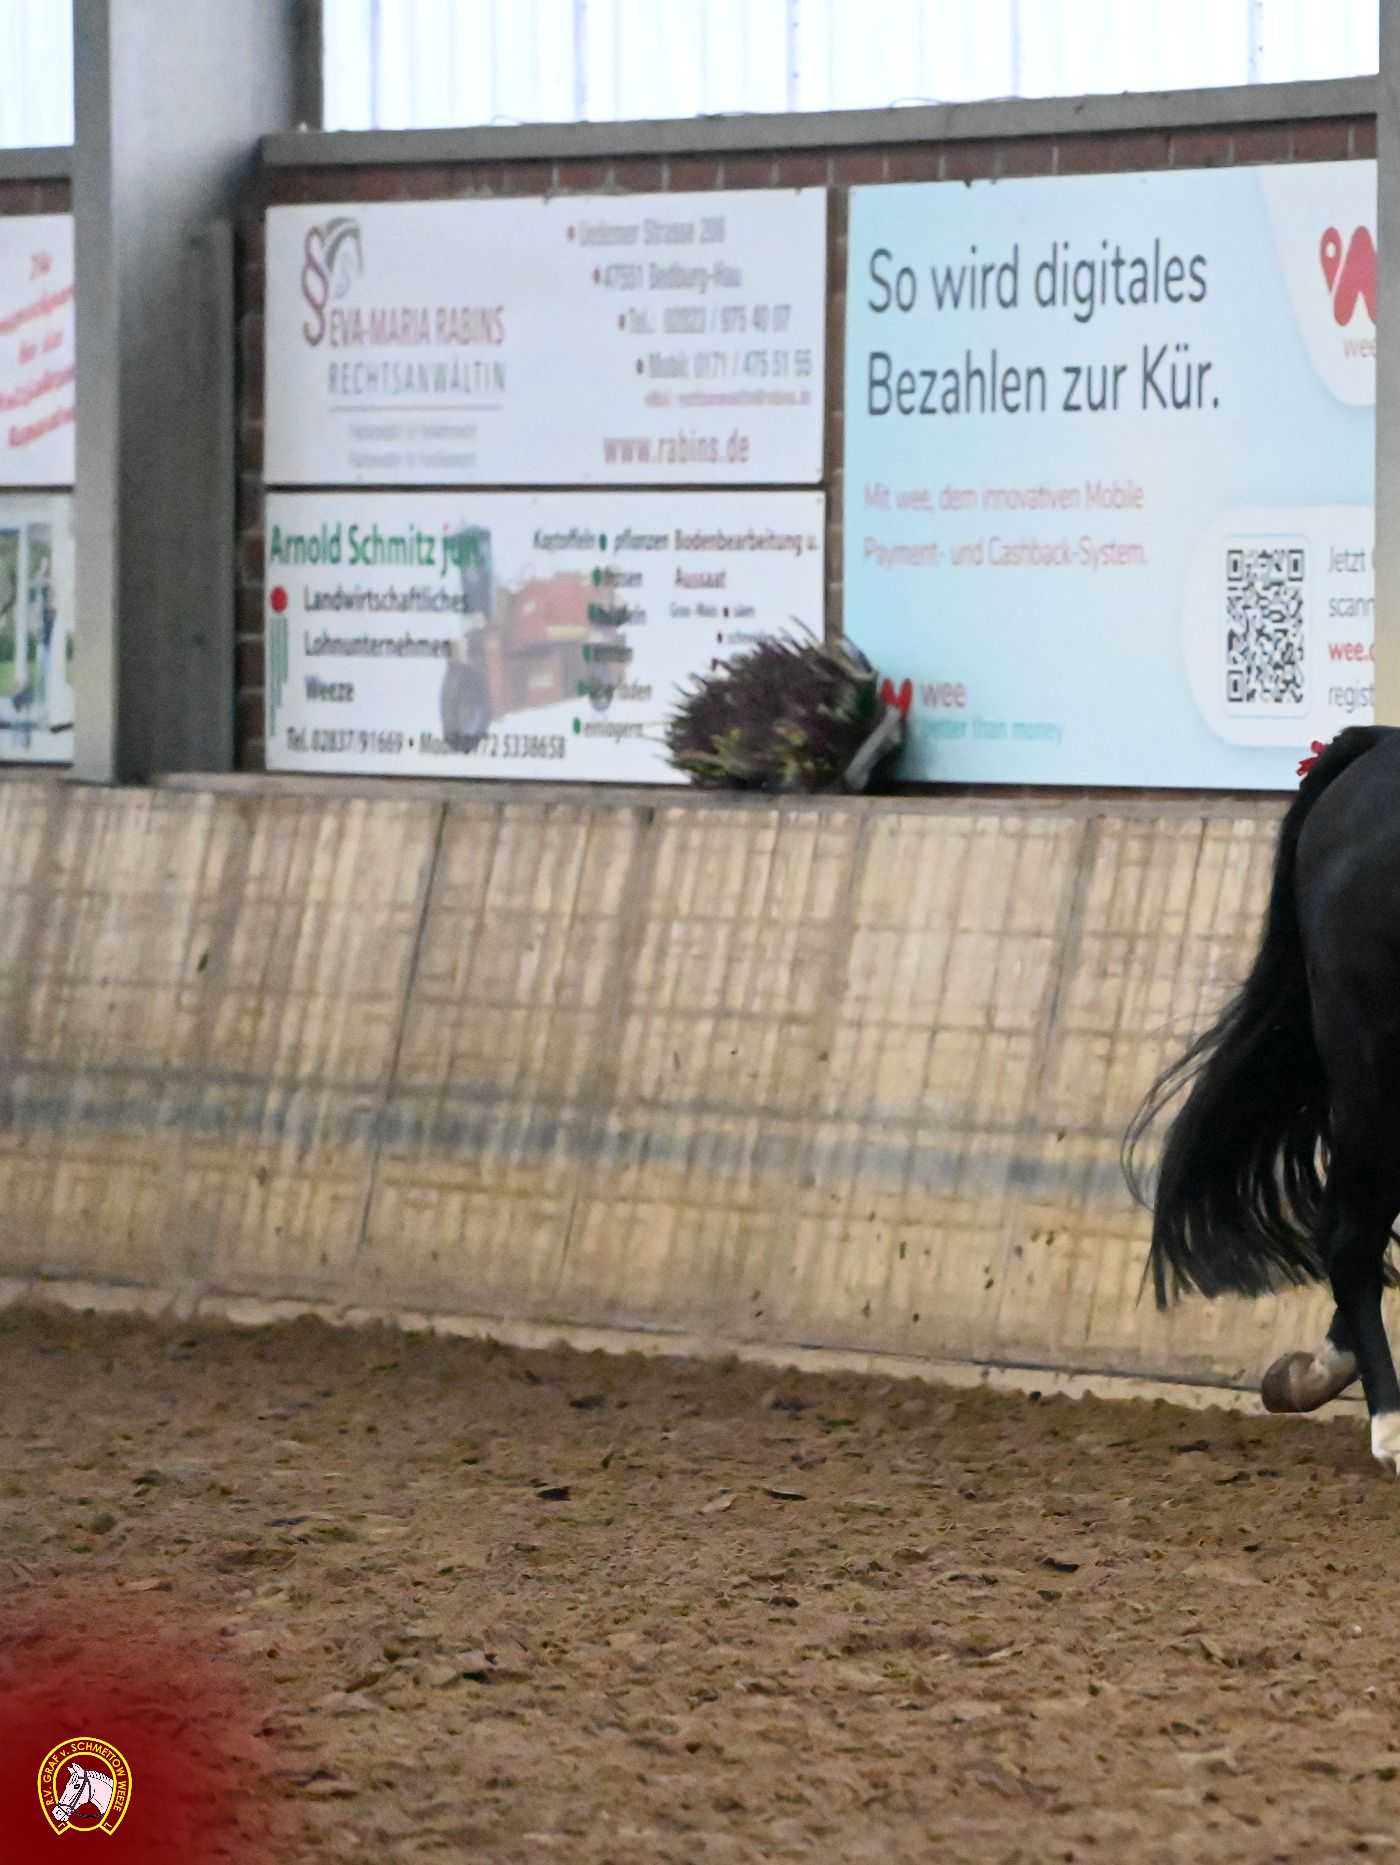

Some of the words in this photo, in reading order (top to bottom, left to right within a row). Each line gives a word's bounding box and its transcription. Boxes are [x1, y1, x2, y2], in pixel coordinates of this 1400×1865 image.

[867, 248, 917, 313] So
[931, 243, 1019, 312] wird
[1034, 238, 1207, 324] digitales
[436, 305, 506, 345] RABINS
[328, 357, 506, 396] RECHTSANWÄLTIN
[867, 350, 1046, 417] Bezahlen
[1062, 360, 1127, 412] zur
[1142, 342, 1220, 411] Kür.
[603, 428, 750, 464] www.rabins.de
[270, 523, 342, 565] Arnold
[348, 522, 436, 566] Schmitz
[674, 528, 803, 557] Bodenbearbeitung
[1328, 545, 1366, 574] Jetzt
[304, 674, 355, 703] Weeze
[921, 681, 967, 708] wee
